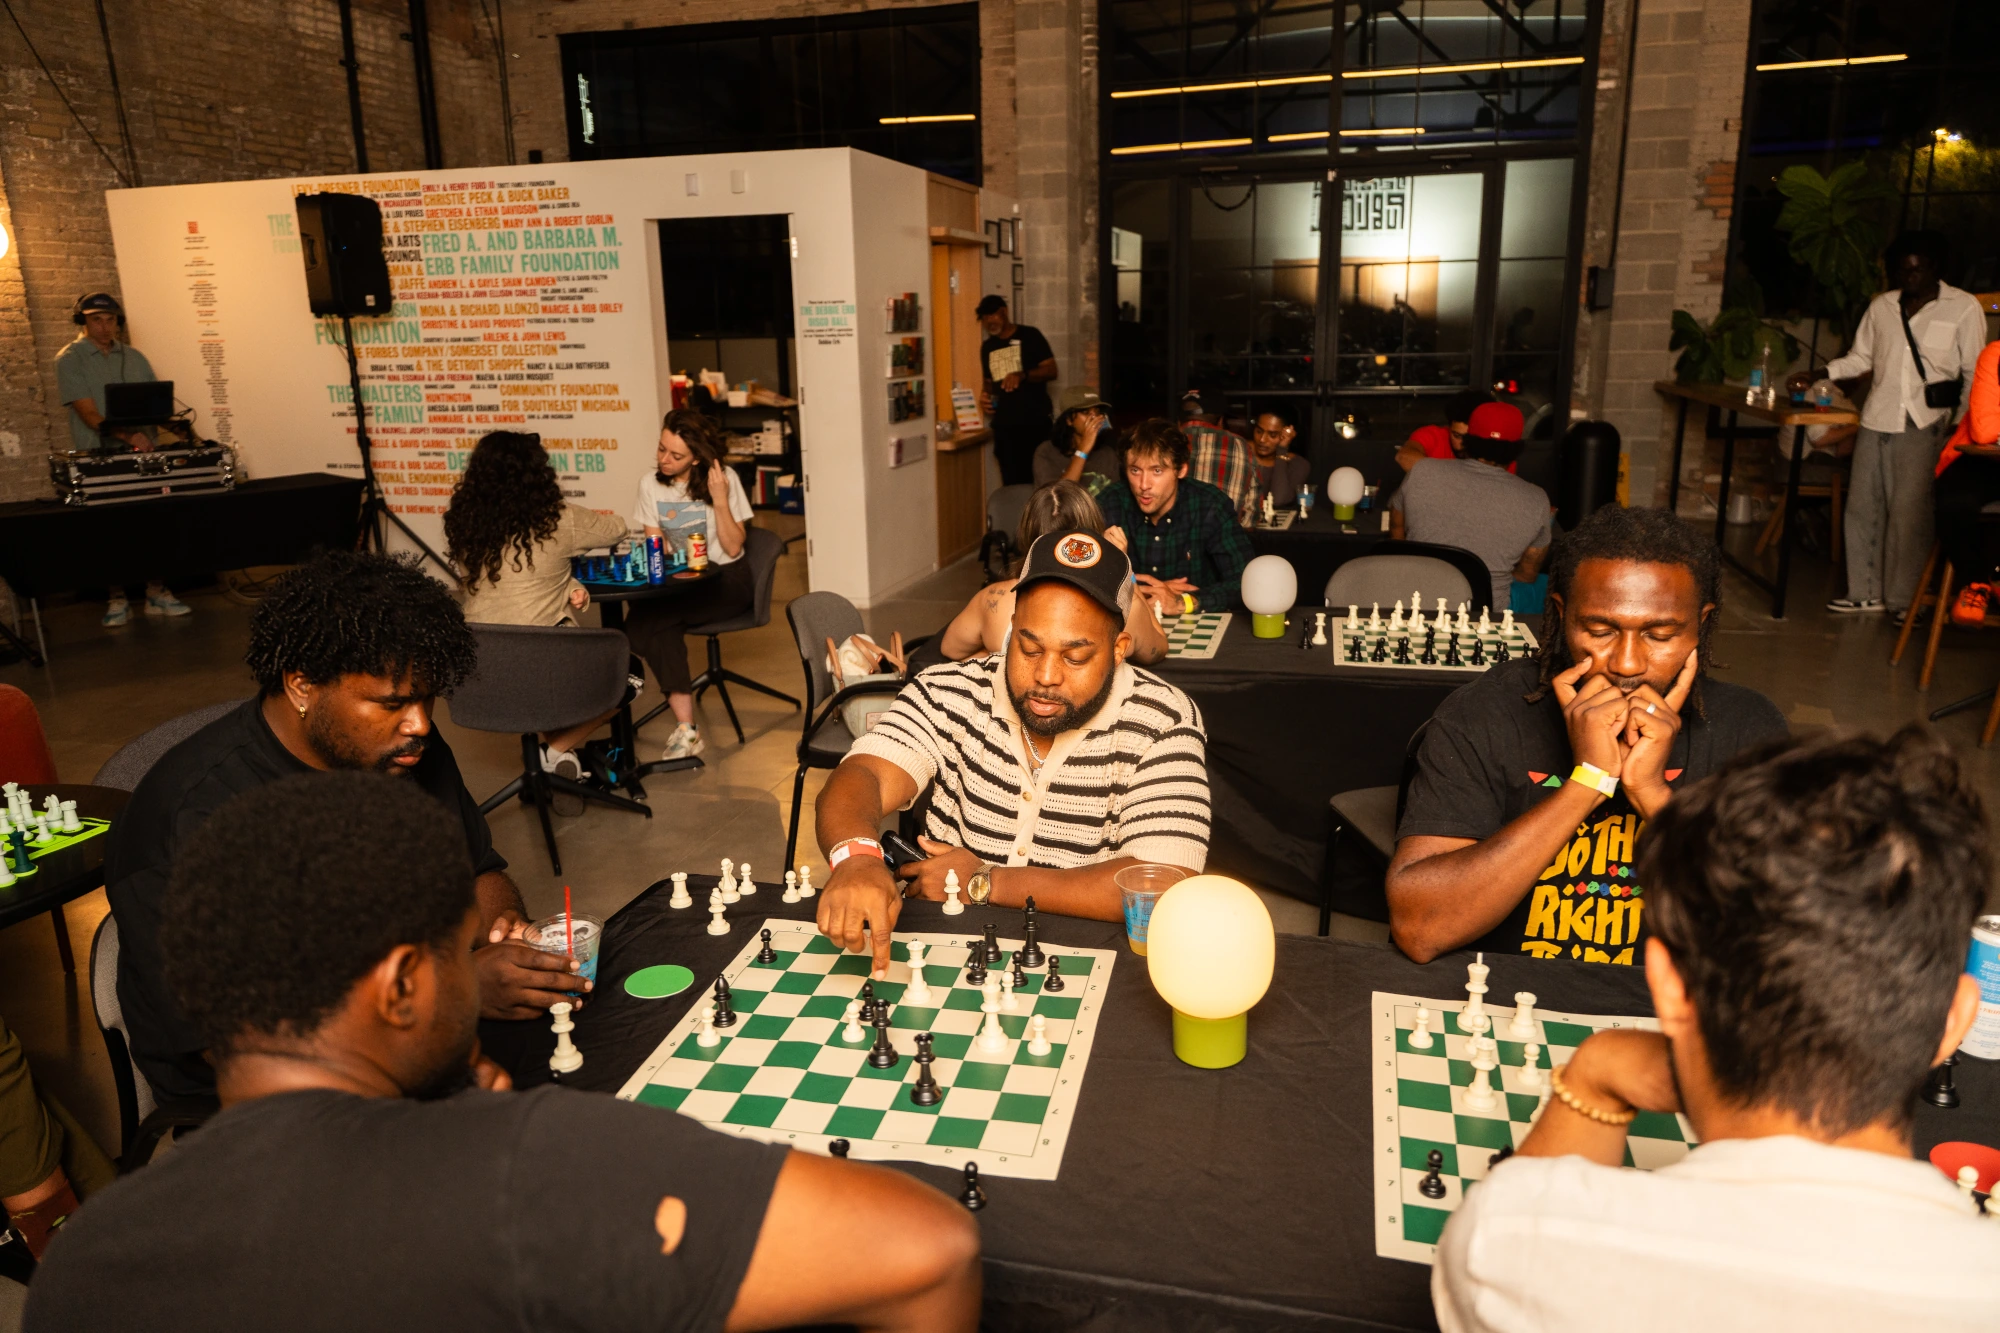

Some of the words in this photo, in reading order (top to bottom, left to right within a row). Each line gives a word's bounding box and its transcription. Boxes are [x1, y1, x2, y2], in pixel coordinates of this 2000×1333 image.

[362, 178, 421, 193] FOUNDATION
[422, 184, 440, 192] EMILY
[442, 184, 448, 192] &
[450, 182, 470, 192] HENRY
[470, 182, 486, 190] FORD
[423, 192, 466, 207] CHRISTIE
[468, 192, 494, 206] PECK
[496, 190, 504, 203] &
[508, 188, 536, 203] BUCK
[537, 187, 570, 201] BAKER
[425, 208, 464, 218] GRETCHEN
[466, 206, 472, 217] &
[474, 206, 499, 217] ETHAN
[501, 204, 539, 216] DAVIDSON
[267, 214, 294, 236] THE
[393, 220, 400, 233] &
[404, 218, 445, 233] STEPHEN
[449, 216, 501, 232] EISENBERG
[502, 218, 524, 229] MARY
[526, 216, 542, 228] ANN
[544, 216, 551, 227] &
[554, 215, 583, 227] ROBERT
[586, 214, 614, 226] GORLIN
[397, 234, 421, 248] ARTS
[422, 233, 461, 254] FRED
[467, 232, 482, 252] A.
[487, 230, 518, 252] AND
[523, 228, 597, 250] BARBARA
[602, 226, 623, 247] M.
[384, 250, 423, 262] COUNCIL
[416, 264, 424, 276] &
[425, 256, 455, 277] ERB
[460, 254, 514, 276] FAMILY
[520, 251, 620, 273] FOUNDATION
[398, 278, 426, 290] JAFFE
[428, 279, 458, 289] ANDREW
[469, 278, 475, 288] &
[477, 278, 500, 288] GAYLE
[501, 277, 522, 287] SHAW
[524, 276, 557, 287] CAMDEN
[472, 290, 488, 298] JOHN
[420, 304, 447, 317] MONA
[450, 304, 458, 316] &
[460, 303, 500, 316] RICHARD
[504, 302, 540, 316] ALONZO
[541, 304, 571, 314] MARCIE
[572, 304, 579, 314] &
[582, 303, 597, 313] ROB
[598, 302, 624, 312] ORLEY
[421, 320, 458, 330] CHRISTINE
[461, 320, 467, 329] &
[469, 319, 491, 329] DAVID
[492, 318, 526, 328] PROVOST
[316, 319, 421, 346] FOUNDATION
[482, 332, 511, 342] ARLENE
[512, 332, 519, 342] &
[521, 332, 541, 342] JOHN
[543, 330, 566, 341] LEWIS
[366, 346, 398, 358] FORBES
[502, 343, 558, 356] COLLECTION
[416, 360, 424, 372] &
[426, 360, 444, 372] THE
[446, 359, 485, 372] DETROIT
[488, 358, 526, 371] SHOPPE
[327, 385, 354, 404] THE
[360, 384, 422, 404] WALTERS
[500, 384, 558, 397] COMMUNITY
[560, 383, 620, 396] FOUNDATION
[425, 393, 472, 403] HUNTINGTON
[458, 404, 474, 412] DAVID
[502, 400, 521, 412] FOR
[522, 400, 578, 412] SOUTHEAST
[581, 400, 630, 412] MICHIGAN
[375, 405, 424, 425] FAMILY
[428, 414, 465, 424] ANNMARIE
[467, 414, 474, 424] &
[475, 414, 491, 424] NEIL
[493, 414, 526, 424] HAWKINS
[392, 439, 398, 448] &
[400, 439, 420, 448] DAVID
[422, 439, 453, 449] CARROLL
[543, 438, 574, 450] SIMON
[577, 438, 618, 451] LEOPOLD
[400, 461, 406, 470] &
[407, 460, 421, 470] BOB
[423, 460, 446, 470] SACHS
[574, 452, 606, 473] ERB
[394, 487, 418, 496] ALFRED
[406, 504, 436, 514] BREWING
[654, 550, 662, 578] ULTRA
[1524, 884, 1646, 946] RIGHT
